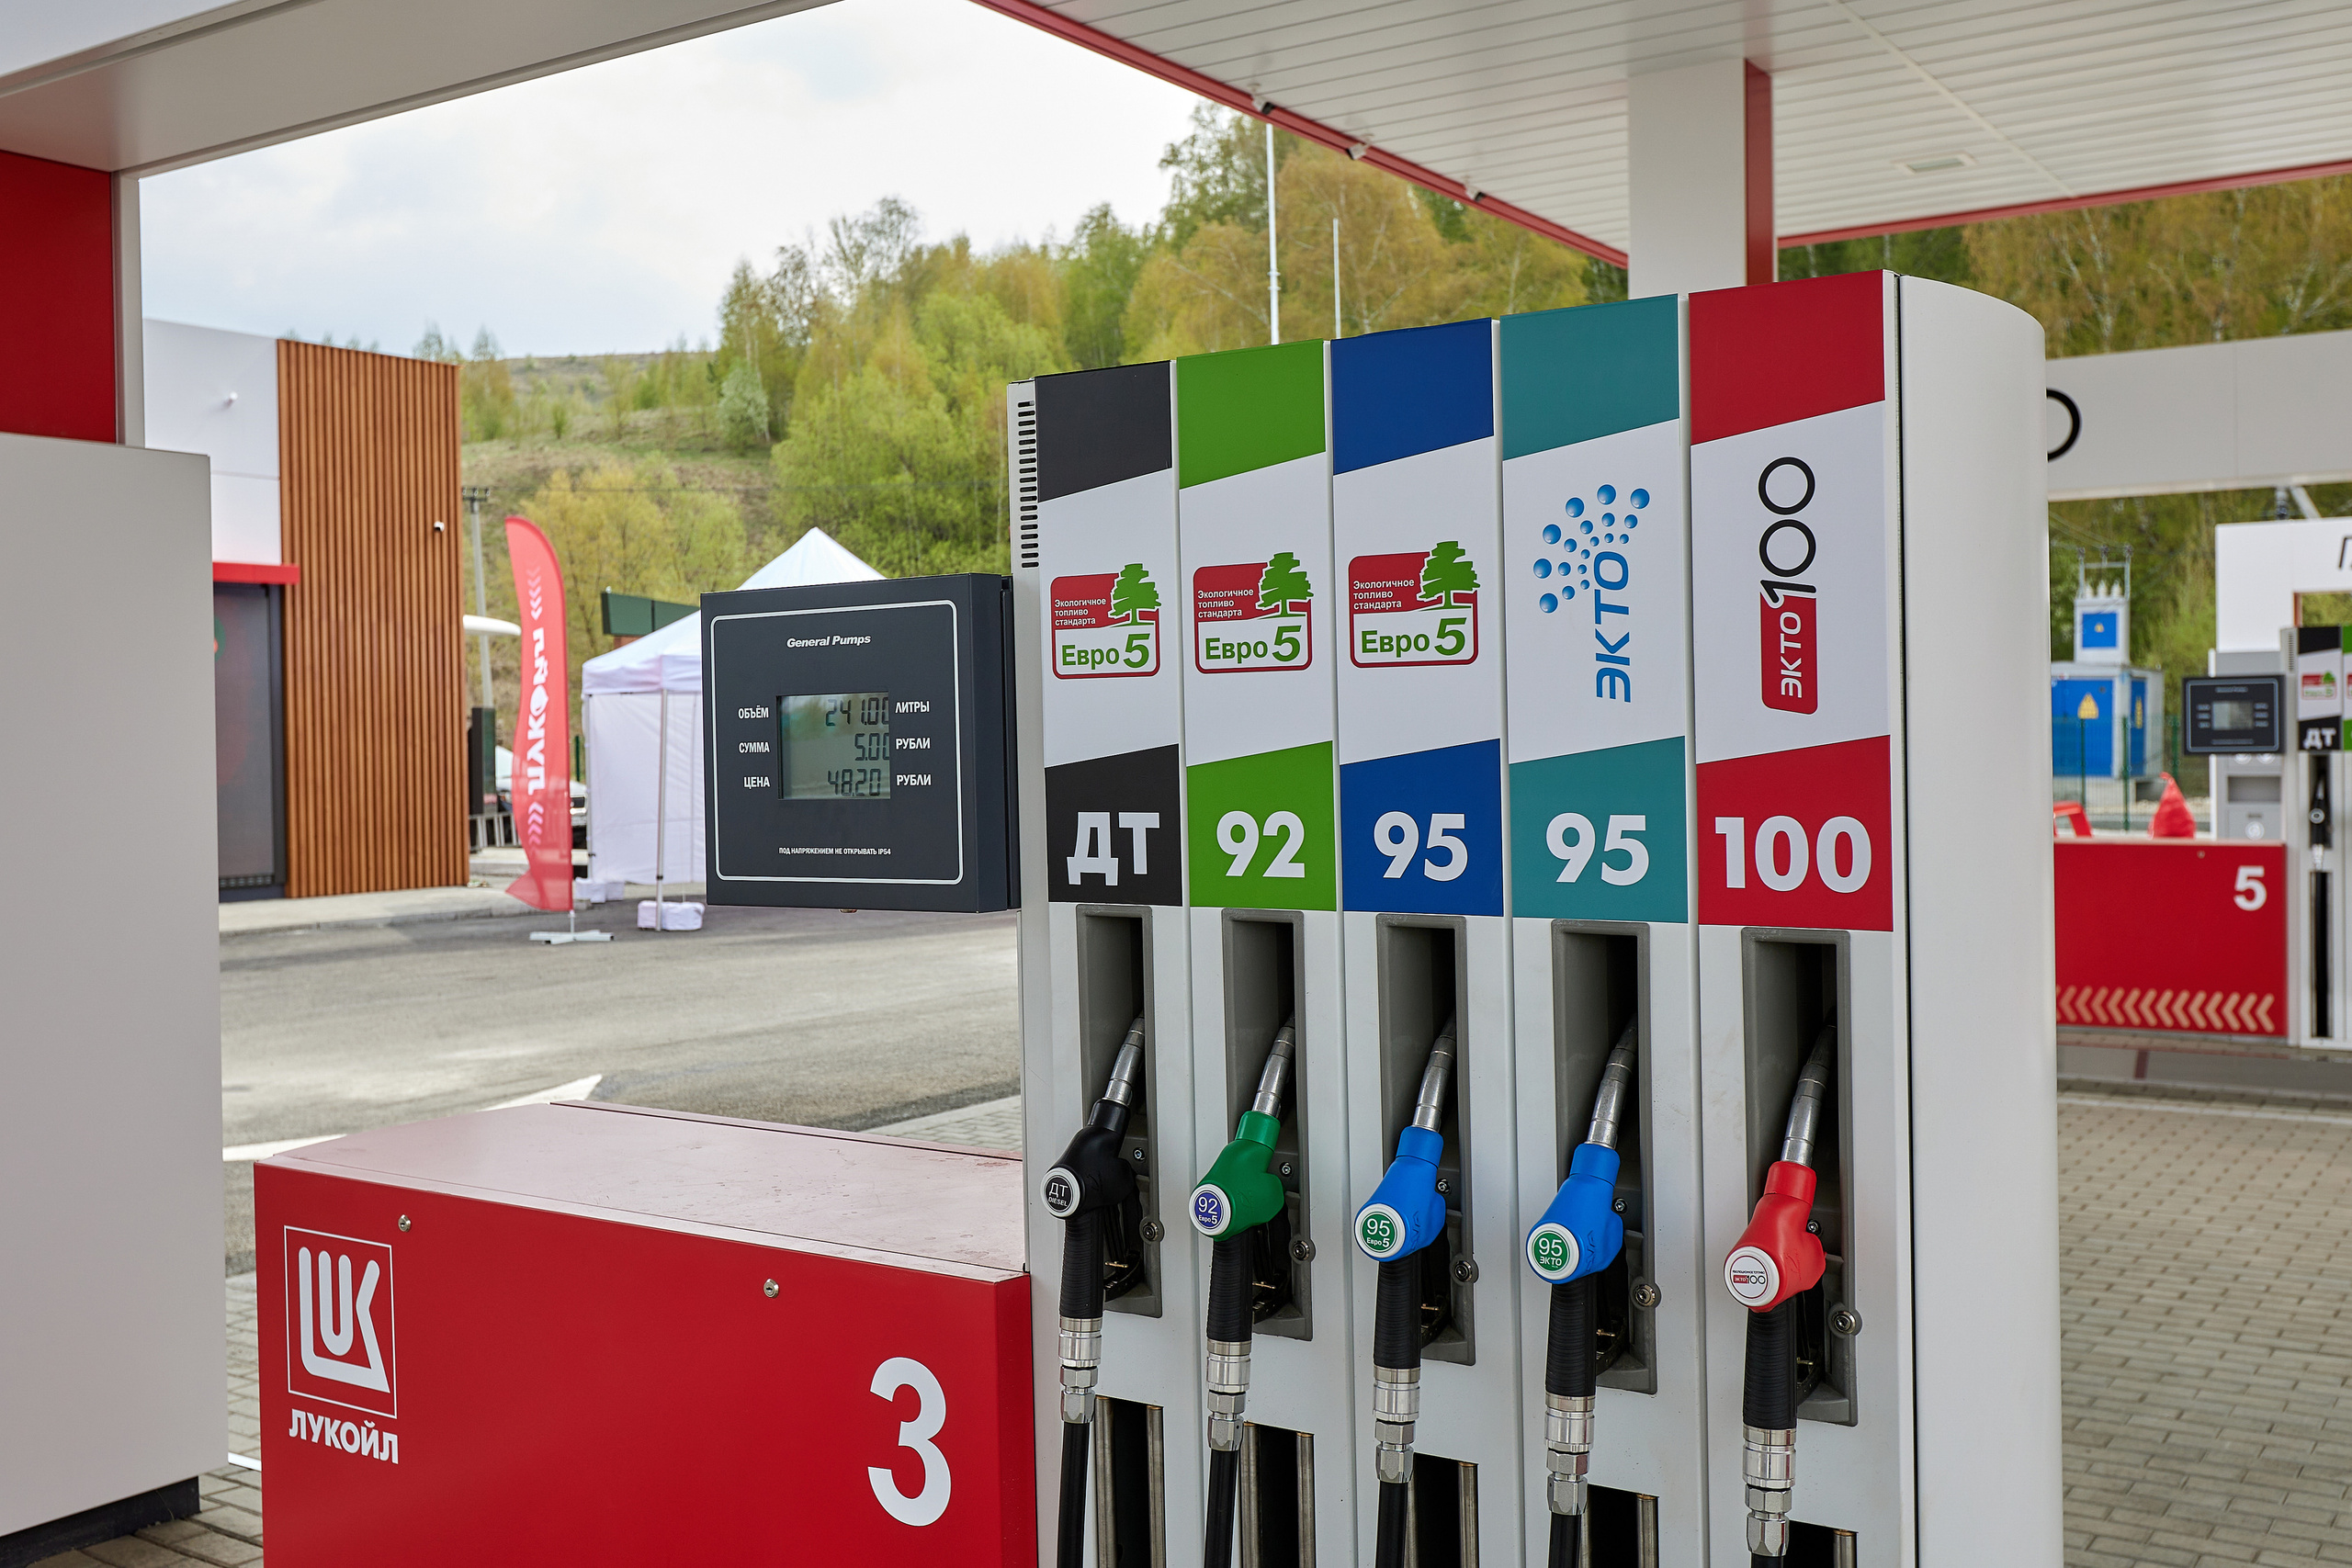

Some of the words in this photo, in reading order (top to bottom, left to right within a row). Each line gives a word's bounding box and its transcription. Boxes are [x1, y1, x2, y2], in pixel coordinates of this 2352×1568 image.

[1758, 457, 1817, 604] 100
[1352, 578, 1415, 591] Экологичное
[1197, 587, 1254, 600] Экологичное
[1352, 590, 1393, 601] топливо
[1055, 597, 1106, 608] Экологичное
[1197, 599, 1235, 610] топливо
[1353, 599, 1402, 611] стандарта
[1055, 608, 1089, 618] топливо
[1198, 608, 1242, 619] стандарта
[1055, 616, 1096, 626] стандарта
[1593, 551, 1631, 703] ЭКТО
[787, 637, 830, 649] General
[831, 635, 871, 647] Pumps
[1361, 630, 1430, 658] Евро
[1434, 617, 1467, 656] 5
[1061, 645, 1120, 670] Евро
[1123, 634, 1151, 669] 5
[1204, 637, 1268, 664] Евро
[1272, 626, 1303, 661] 5
[1780, 612, 1803, 699] ЭКТО
[738, 705, 769, 719] ОБЪЁМ
[895, 701, 930, 714] ЛИТРЫ
[896, 738, 931, 750] РУБЛИ
[2303, 728, 2336, 750] ДТ
[739, 742, 770, 754] СУММА
[743, 776, 770, 789] ЦЕНА
[897, 774, 932, 786] РУБЛИ
[1067, 812, 1160, 886] ДТ
[1216, 811, 1306, 878] 92
[1374, 811, 1468, 882] 95
[1545, 813, 1649, 886] 95
[1714, 816, 1872, 893] 100
[2233, 865, 2267, 911] 5
[1049, 1182, 1069, 1198] ДТ
[1048, 1197, 1068, 1207] DIESEL
[1198, 1197, 1217, 1214] 92
[1212, 1215, 1217, 1224] 5
[1367, 1218, 1390, 1237] 95
[1366, 1237, 1382, 1246] Евро
[1383, 1238, 1390, 1247] 5
[1539, 1237, 1562, 1257] 95
[1540, 1256, 1562, 1266] ЭКТО
[288, 1409, 399, 1465] ЛУКОЙЛ
[867, 1357, 952, 1527] 3
